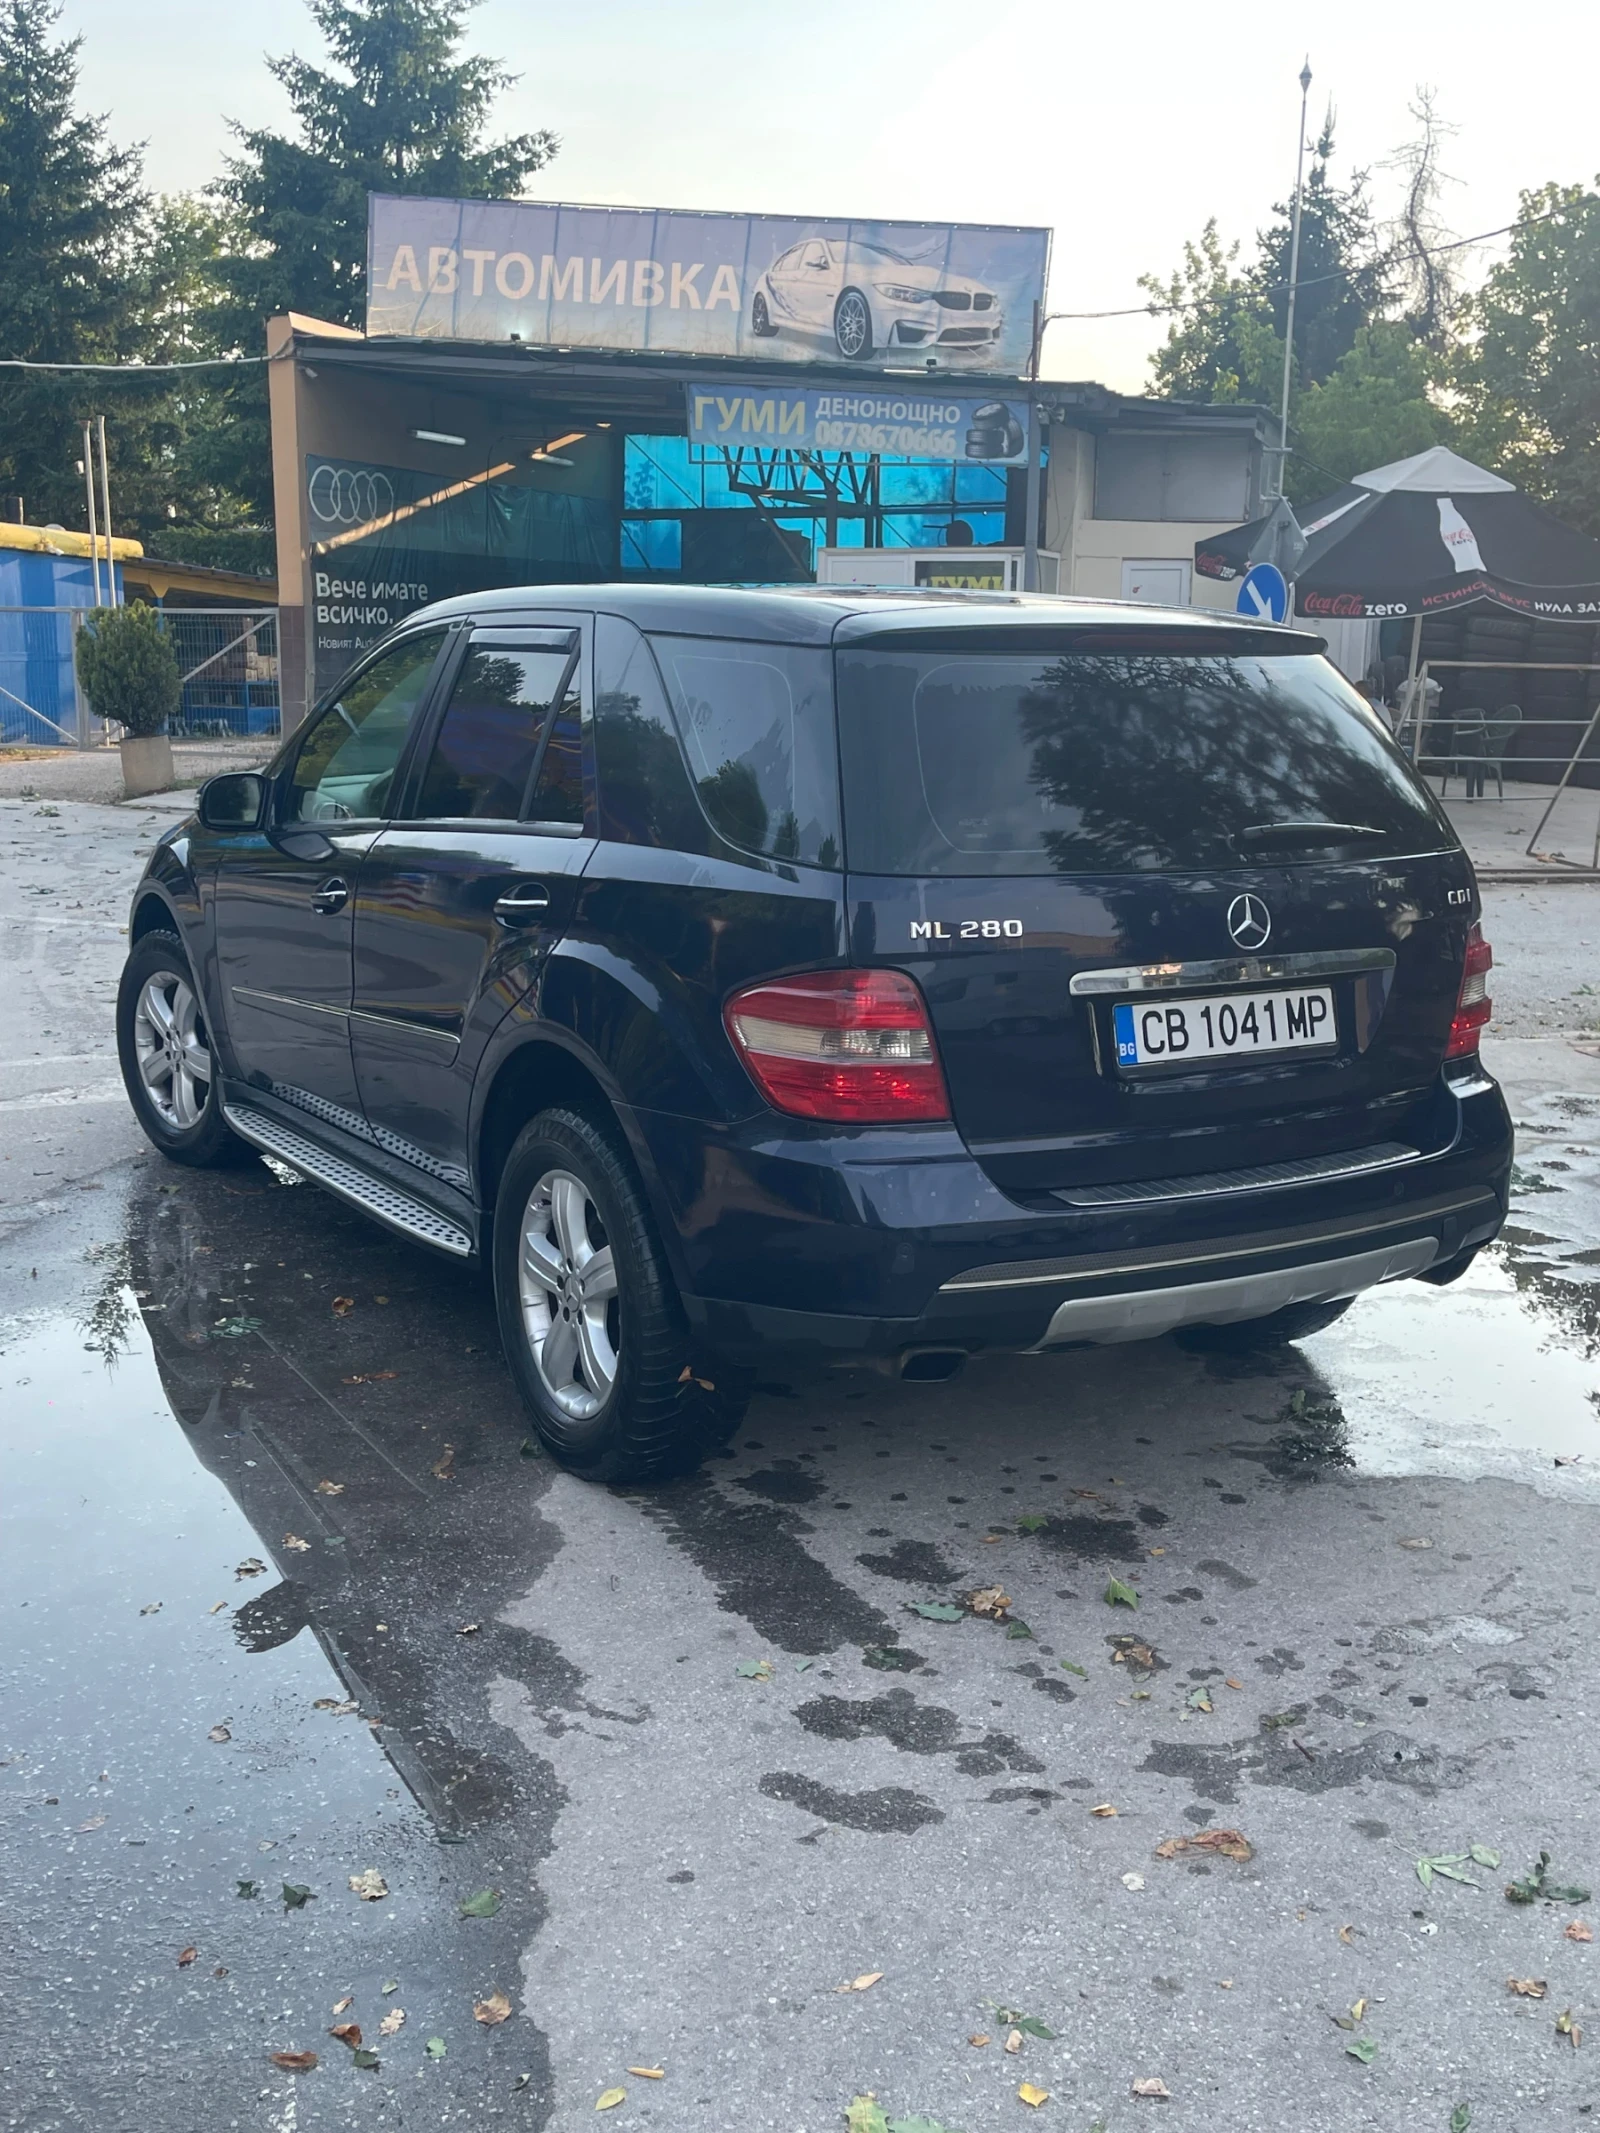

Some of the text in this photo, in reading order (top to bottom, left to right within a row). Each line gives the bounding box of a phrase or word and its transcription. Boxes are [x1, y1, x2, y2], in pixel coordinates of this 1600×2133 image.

[385, 244, 742, 312] АВТОМИВКА
[694, 395, 806, 436] ГУМИ
[815, 397, 961, 426] ДЕНОНОЩНО
[815, 420, 957, 455] 0878670666
[315, 572, 429, 601] Вече имате
[317, 605, 394, 625] всичко.
[1364, 603, 1408, 616] zero
[1534, 601, 1573, 614] НУЛА
[318, 636, 353, 649] Новият
[1447, 887, 1471, 905] CDI
[909, 919, 1023, 939] ML 280
[1141, 995, 1327, 1055] CB 1041 MP
[1119, 1042, 1136, 1057] BG
